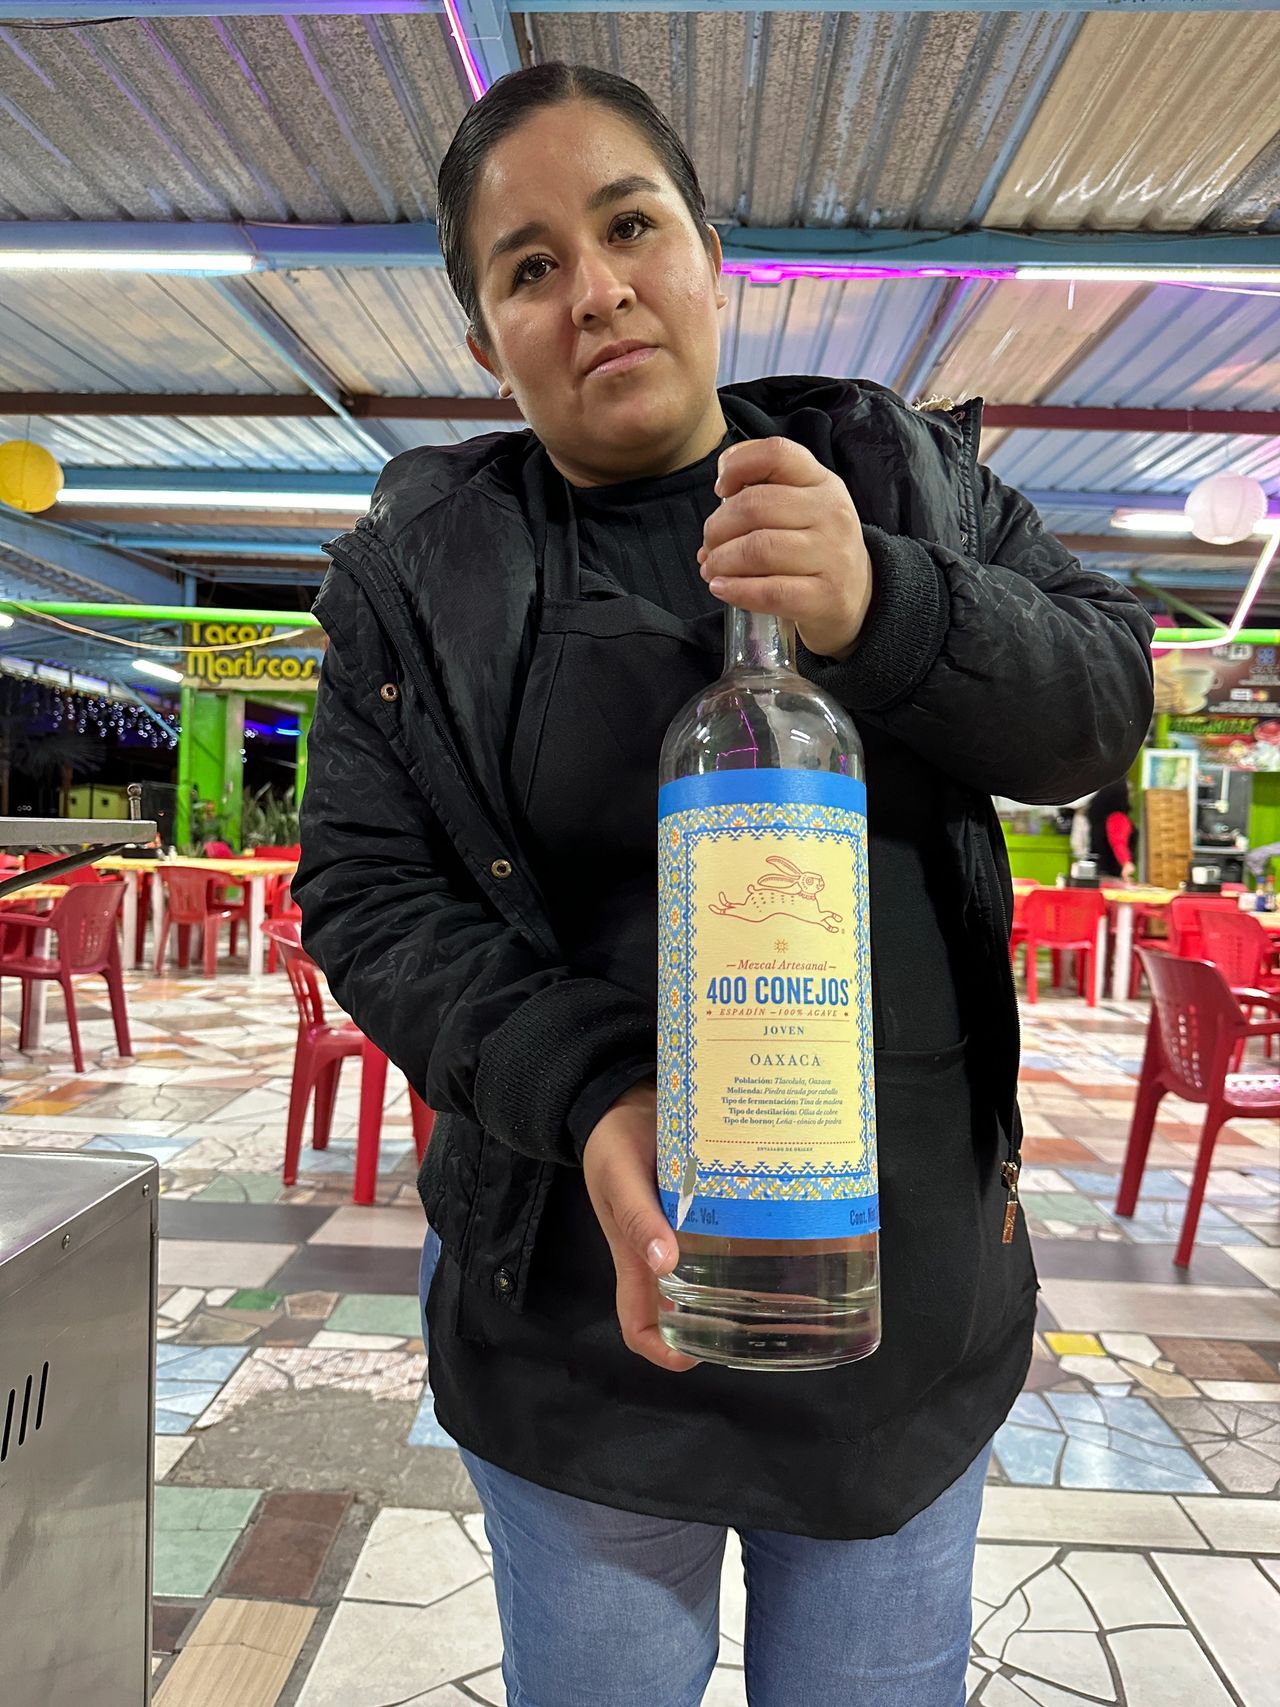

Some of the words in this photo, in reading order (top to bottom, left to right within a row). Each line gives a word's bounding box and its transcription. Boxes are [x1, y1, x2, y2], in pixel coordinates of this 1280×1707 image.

[187, 649, 317, 684] Mariscos
[737, 959, 776, 971] Mezcal
[777, 960, 828, 971] Artesanal
[706, 976, 747, 1005] 400
[755, 976, 849, 1007] CONEJOS
[719, 1007, 766, 1017] ESPADÍN
[807, 1008, 838, 1017] AGAVE
[763, 1026, 805, 1036] JOVEN
[750, 1053, 822, 1067] OAXACA
[734, 1076, 773, 1085] Población:
[727, 1086, 763, 1095] Molienda:
[764, 1087, 785, 1095] Piedra
[806, 1089, 818, 1097] por
[722, 1097, 737, 1106] Tipo
[738, 1097, 747, 1105] de
[748, 1097, 799, 1106] fermentación:
[815, 1098, 823, 1106] de
[729, 1108, 745, 1116] Tipo
[745, 1107, 755, 1115] de
[755, 1107, 798, 1116] destilación:
[722, 1117, 739, 1126] Tipo
[740, 1117, 749, 1125] de
[816, 1118, 824, 1126] de
